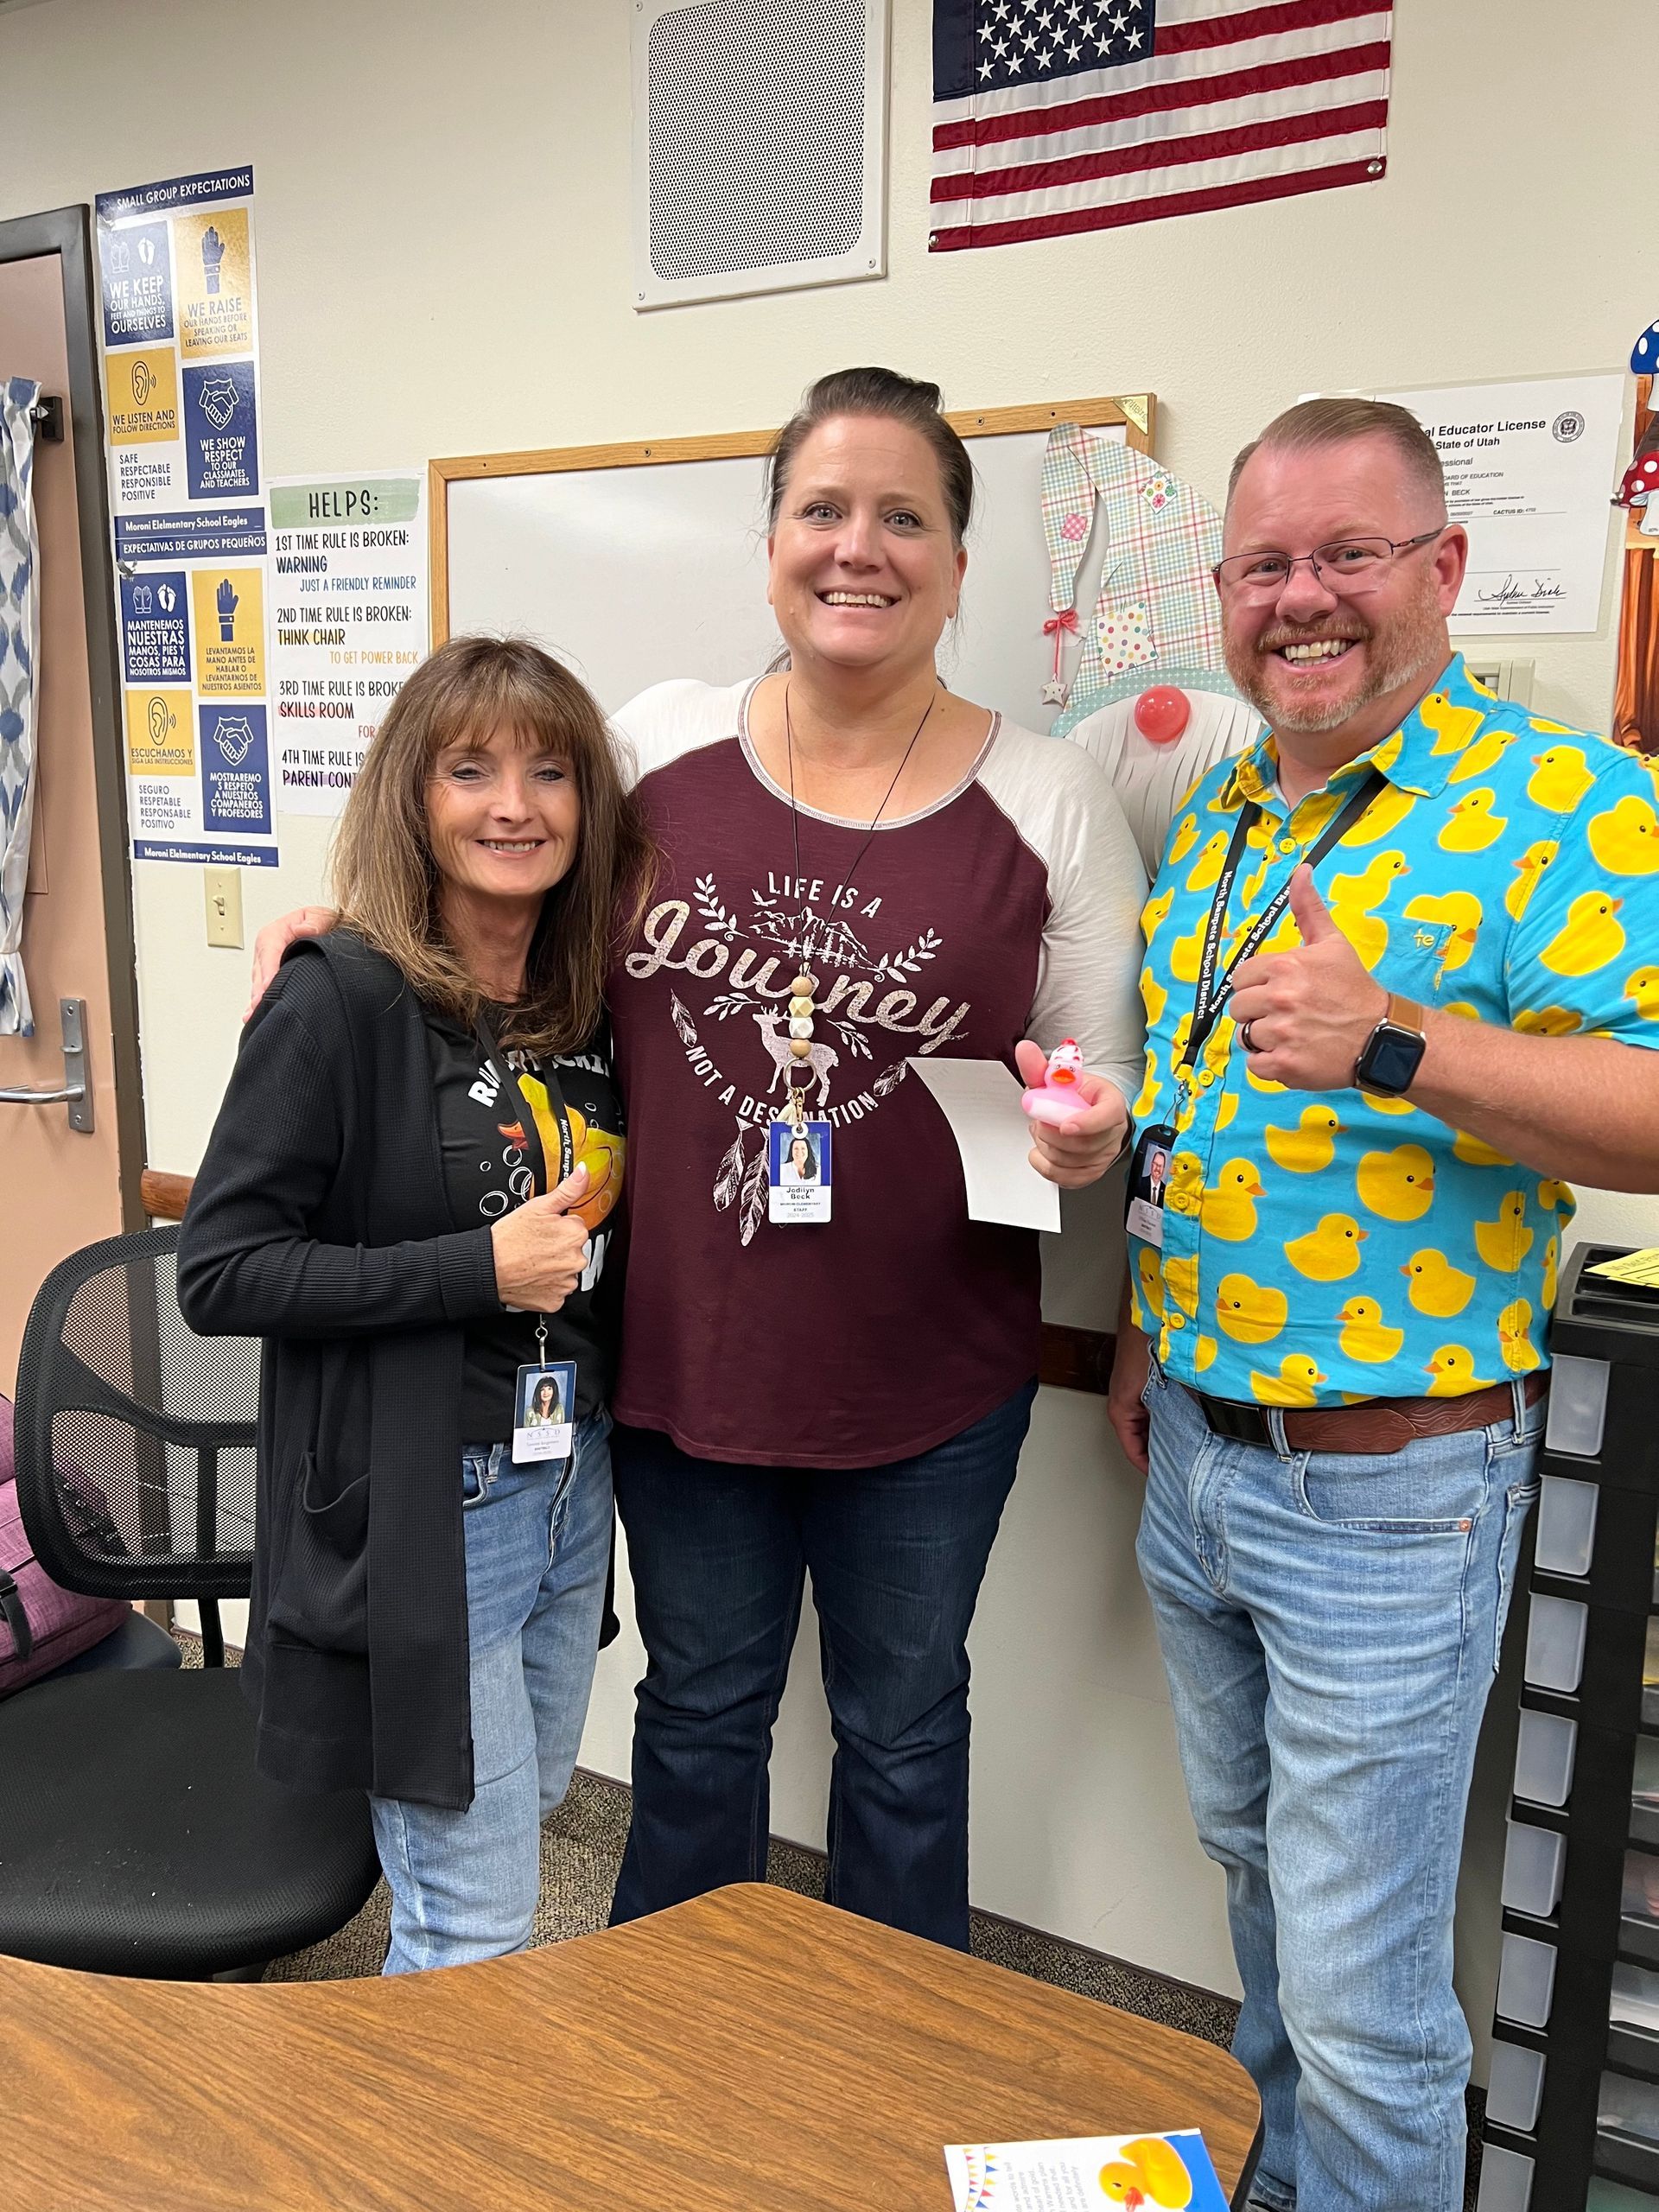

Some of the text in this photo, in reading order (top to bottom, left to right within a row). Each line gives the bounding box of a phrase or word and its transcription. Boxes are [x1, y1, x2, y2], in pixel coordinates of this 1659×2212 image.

[118, 175, 250, 210] SMALL GROUP EXPECTATIONS
[110, 276, 163, 299] WE KEEP
[111, 299, 129, 311] OUR
[188, 297, 241, 317] WE RAISE
[111, 315, 166, 334] OURSELVES
[184, 313, 246, 327] OUR HANDS BEFORE
[194, 326, 226, 336] SPEAKING
[186, 333, 247, 346] LEAVING OUR SEATS
[113, 410, 175, 425] WE LISTEN AND
[113, 422, 175, 434] FOLLOW DIRECTIONS
[1439, 422, 1494, 436] Educator
[1497, 420, 1546, 431] License
[200, 436, 245, 450] WE SHOW
[1436, 437, 1500, 449] State of Utah
[119, 454, 138, 464] SAFE
[205, 449, 243, 462] RESPECT
[1442, 458, 1473, 467] essional
[121, 464, 170, 476] RESPECTABLE
[203, 469, 245, 479] CLASSMATES
[122, 476, 171, 488] RESPONSIBLE
[217, 477, 250, 487] TEACHERS
[122, 490, 156, 501] POSITIVE
[309, 490, 378, 518] HELPS:
[126, 522, 151, 531] Moroni
[196, 517, 221, 528] School
[223, 516, 247, 528] Eagles
[124, 535, 265, 554] EXPECTATIVAS DE GRUPOS PEQUEÑOS
[276, 530, 409, 550] 1ST TIME RULE IS BROKEN:
[276, 556, 327, 574] WARNING
[300, 575, 416, 592] JUST A FRIENDLY REMINDER
[277, 605, 412, 623] 2ND TIME RULE IS BROKEN:
[128, 620, 183, 630] MANTENEMOS
[128, 631, 185, 645] NUESTRAS
[278, 629, 346, 645] THINK CHAIR
[162, 646, 178, 655] PIES
[179, 645, 185, 655] Y
[130, 657, 185, 668] COSAS PARA
[330, 652, 418, 664] TO GET POWER BACK
[162, 667, 186, 676] MISMOS
[279, 681, 404, 696] 3RD TIME RULE IS BROKE
[280, 702, 354, 719] SKILLS ROOM
[359, 725, 376, 738] FOR
[131, 748, 192, 758] ESCUCHAMOS Y
[283, 749, 365, 766] 4TH TIME RULE IS
[210, 772, 261, 782] MOSTRAREMO
[283, 770, 359, 788] PARENT CONT
[139, 785, 169, 794] SEGURO
[218, 782, 222, 791] S
[140, 797, 181, 806] RESPETABLE
[222, 791, 258, 800] NUESTROS
[140, 808, 191, 818] RESPONSABLE
[219, 809, 263, 818] PROFESORES
[141, 819, 175, 829] POSITIVO
[144, 847, 168, 858] Moroni
[212, 852, 236, 861] School
[237, 854, 261, 865] Eagles
[768, 872, 882, 918] LIFE IS A
[1198, 871, 1232, 1020] North Sanpete School District
[685, 1046, 722, 1087] NOT
[718, 1084, 736, 1105] A
[560, 1119, 572, 1180] North Sanpe
